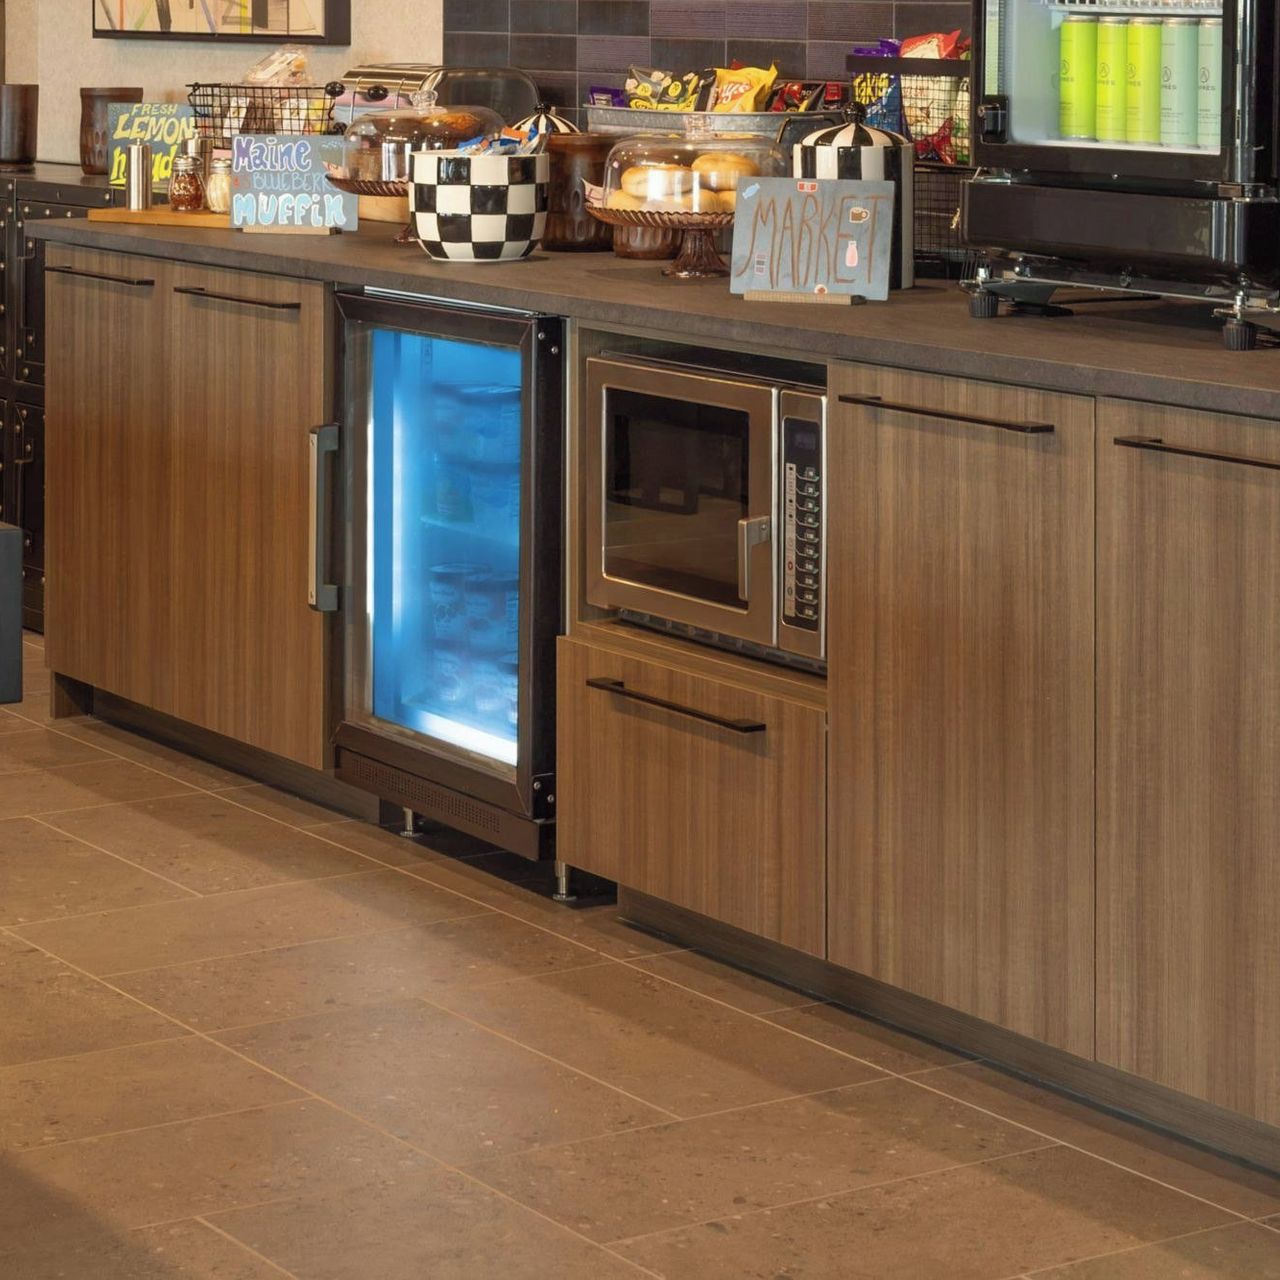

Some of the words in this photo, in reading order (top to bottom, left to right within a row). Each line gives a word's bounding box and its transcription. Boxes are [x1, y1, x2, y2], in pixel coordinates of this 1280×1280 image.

[131, 103, 178, 116] FRESH
[113, 113, 195, 145] LEMON
[233, 135, 312, 172] Maine
[735, 193, 888, 290] MARKET
